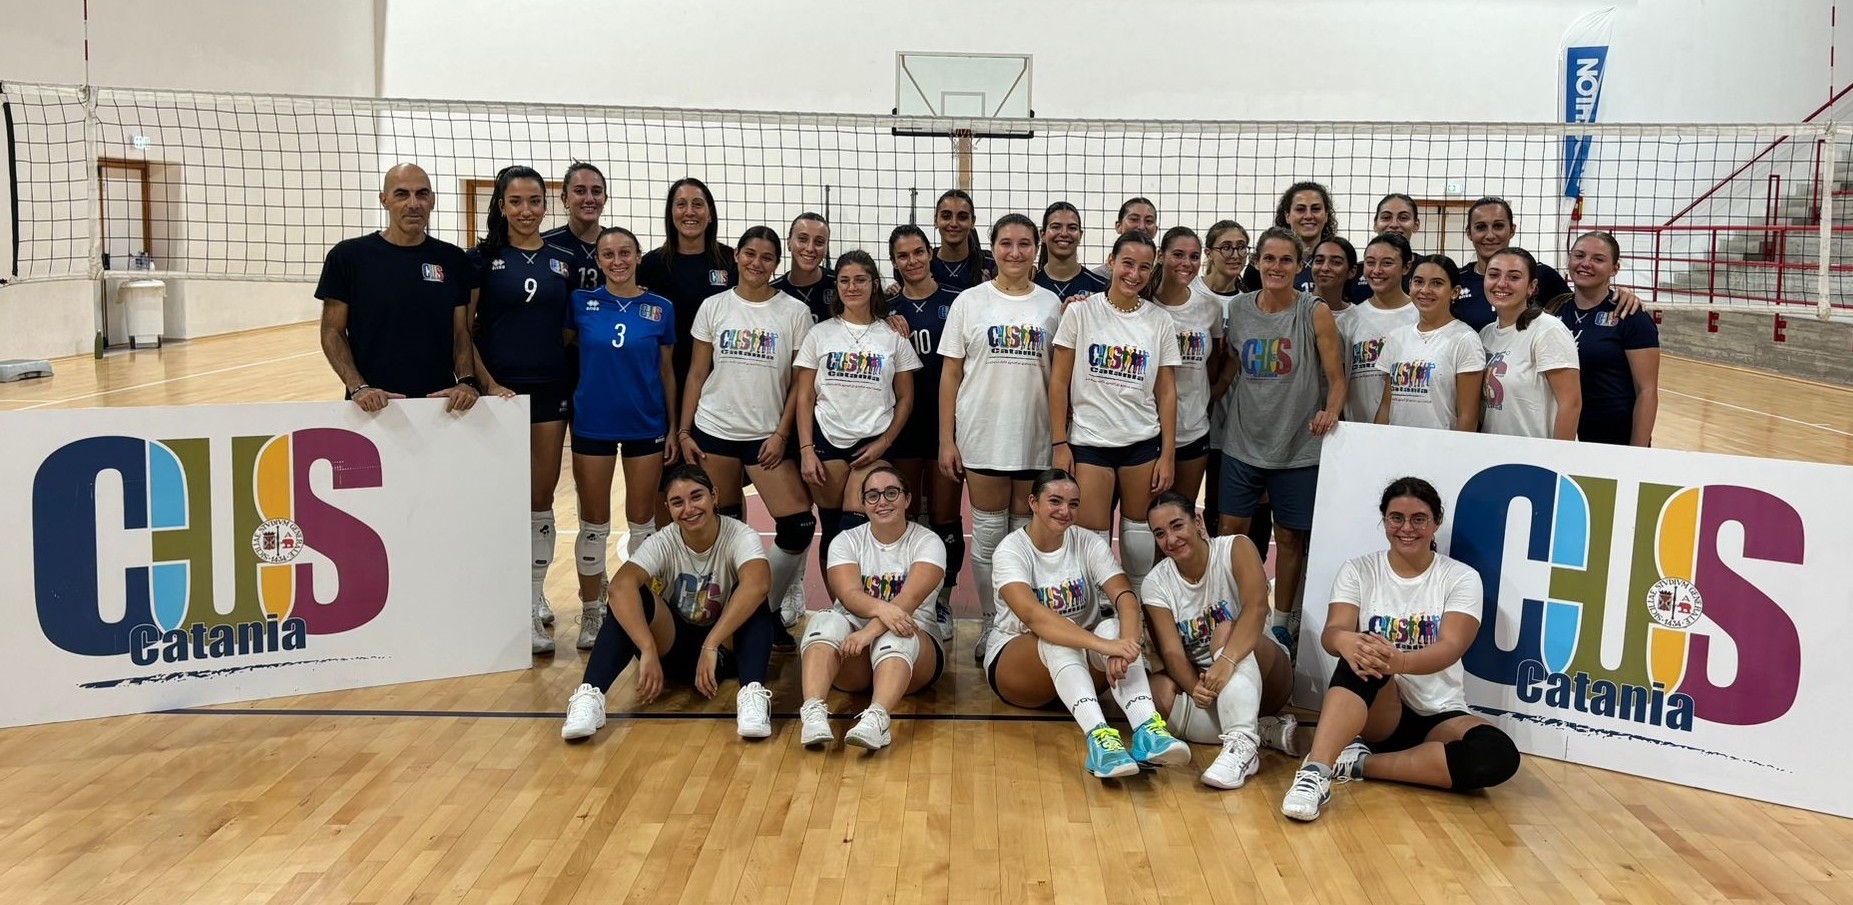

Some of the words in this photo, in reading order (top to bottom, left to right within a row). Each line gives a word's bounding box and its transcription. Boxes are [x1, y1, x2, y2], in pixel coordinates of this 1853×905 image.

[524, 278, 538, 302] 9
[578, 267, 598, 288] 13
[612, 323, 626, 348] 3
[911, 329, 931, 354] 10
[1088, 343, 1123, 369] CUS
[1242, 338, 1292, 375] CUS
[32, 428, 389, 656] CUS
[1449, 463, 1804, 726] CUS
[129, 612, 307, 666] Catania
[1514, 659, 1696, 733] Catania
